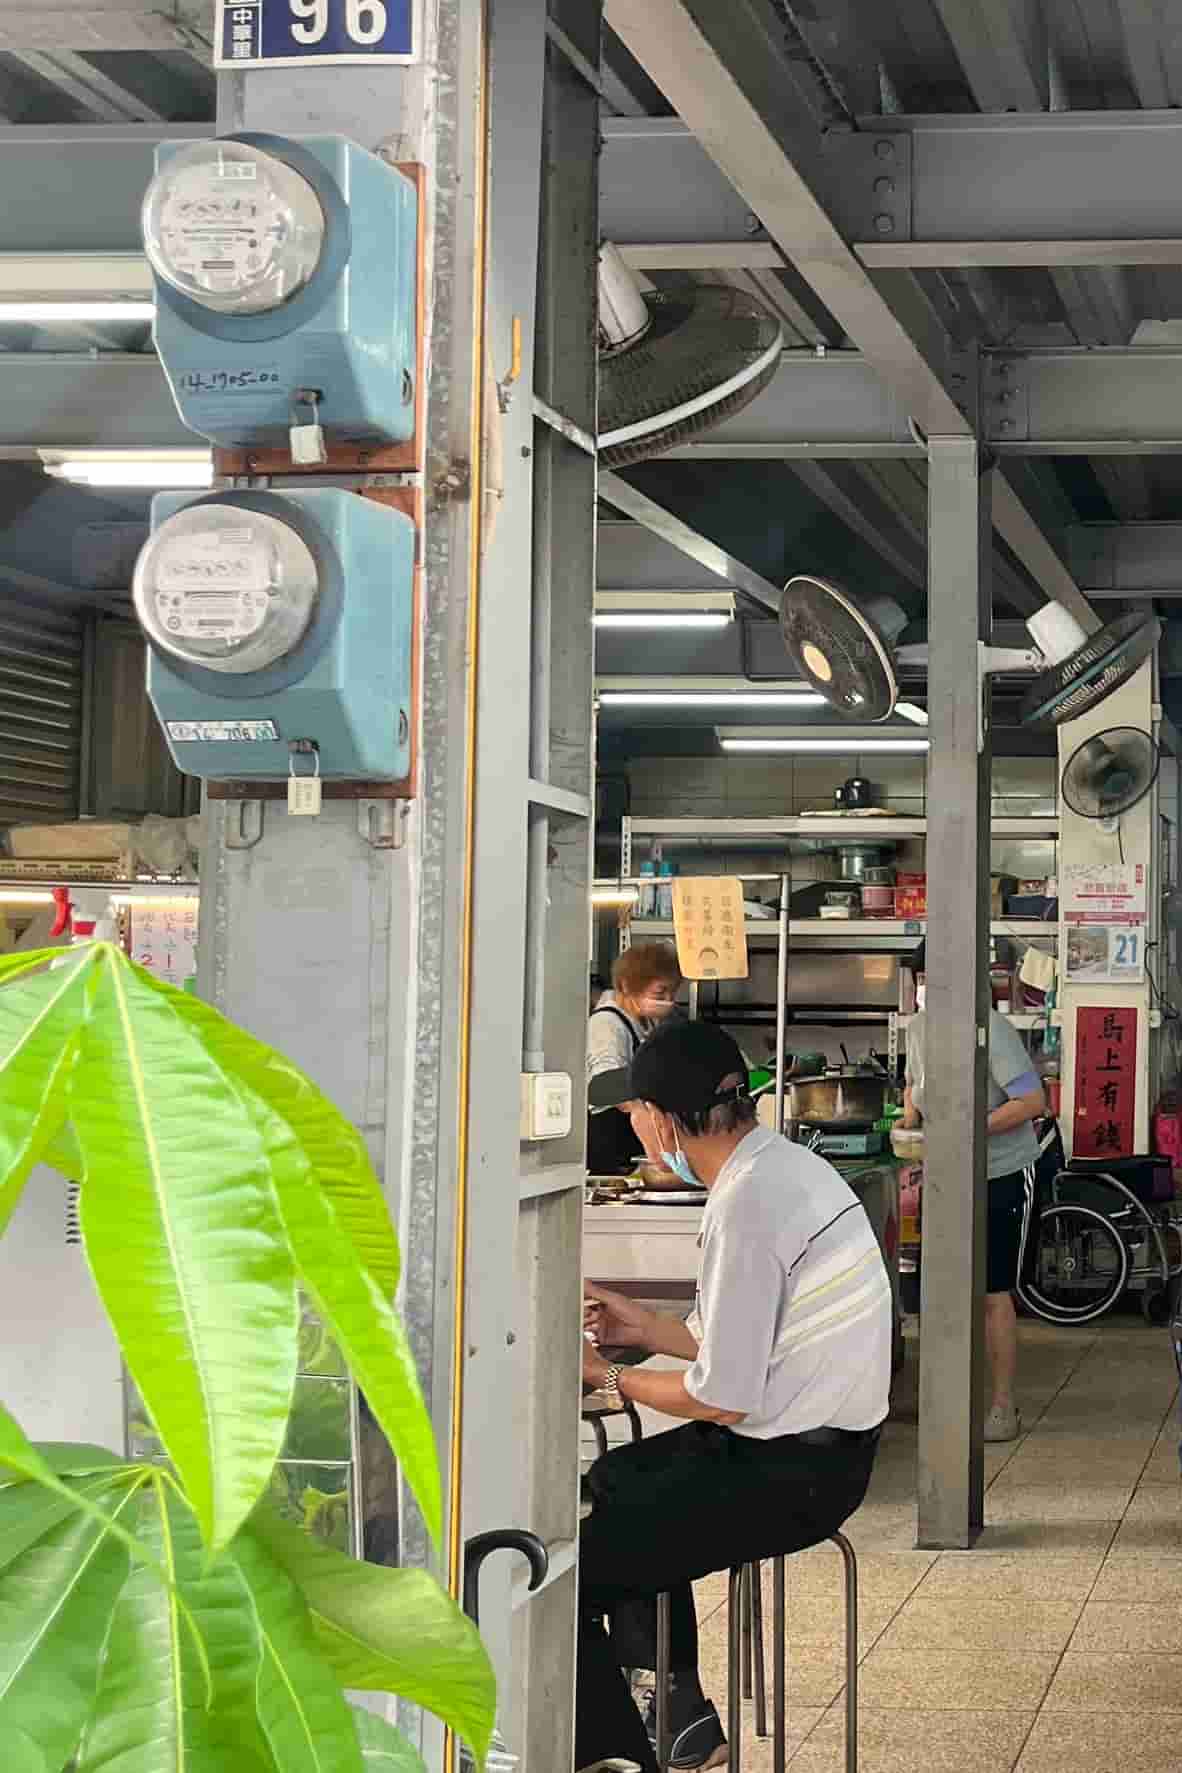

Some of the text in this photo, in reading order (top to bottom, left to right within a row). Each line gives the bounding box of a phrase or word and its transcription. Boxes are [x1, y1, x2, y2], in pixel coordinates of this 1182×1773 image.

[1115, 934, 1138, 964] 21
[1091, 1010, 1125, 1152] 馬上有錢
